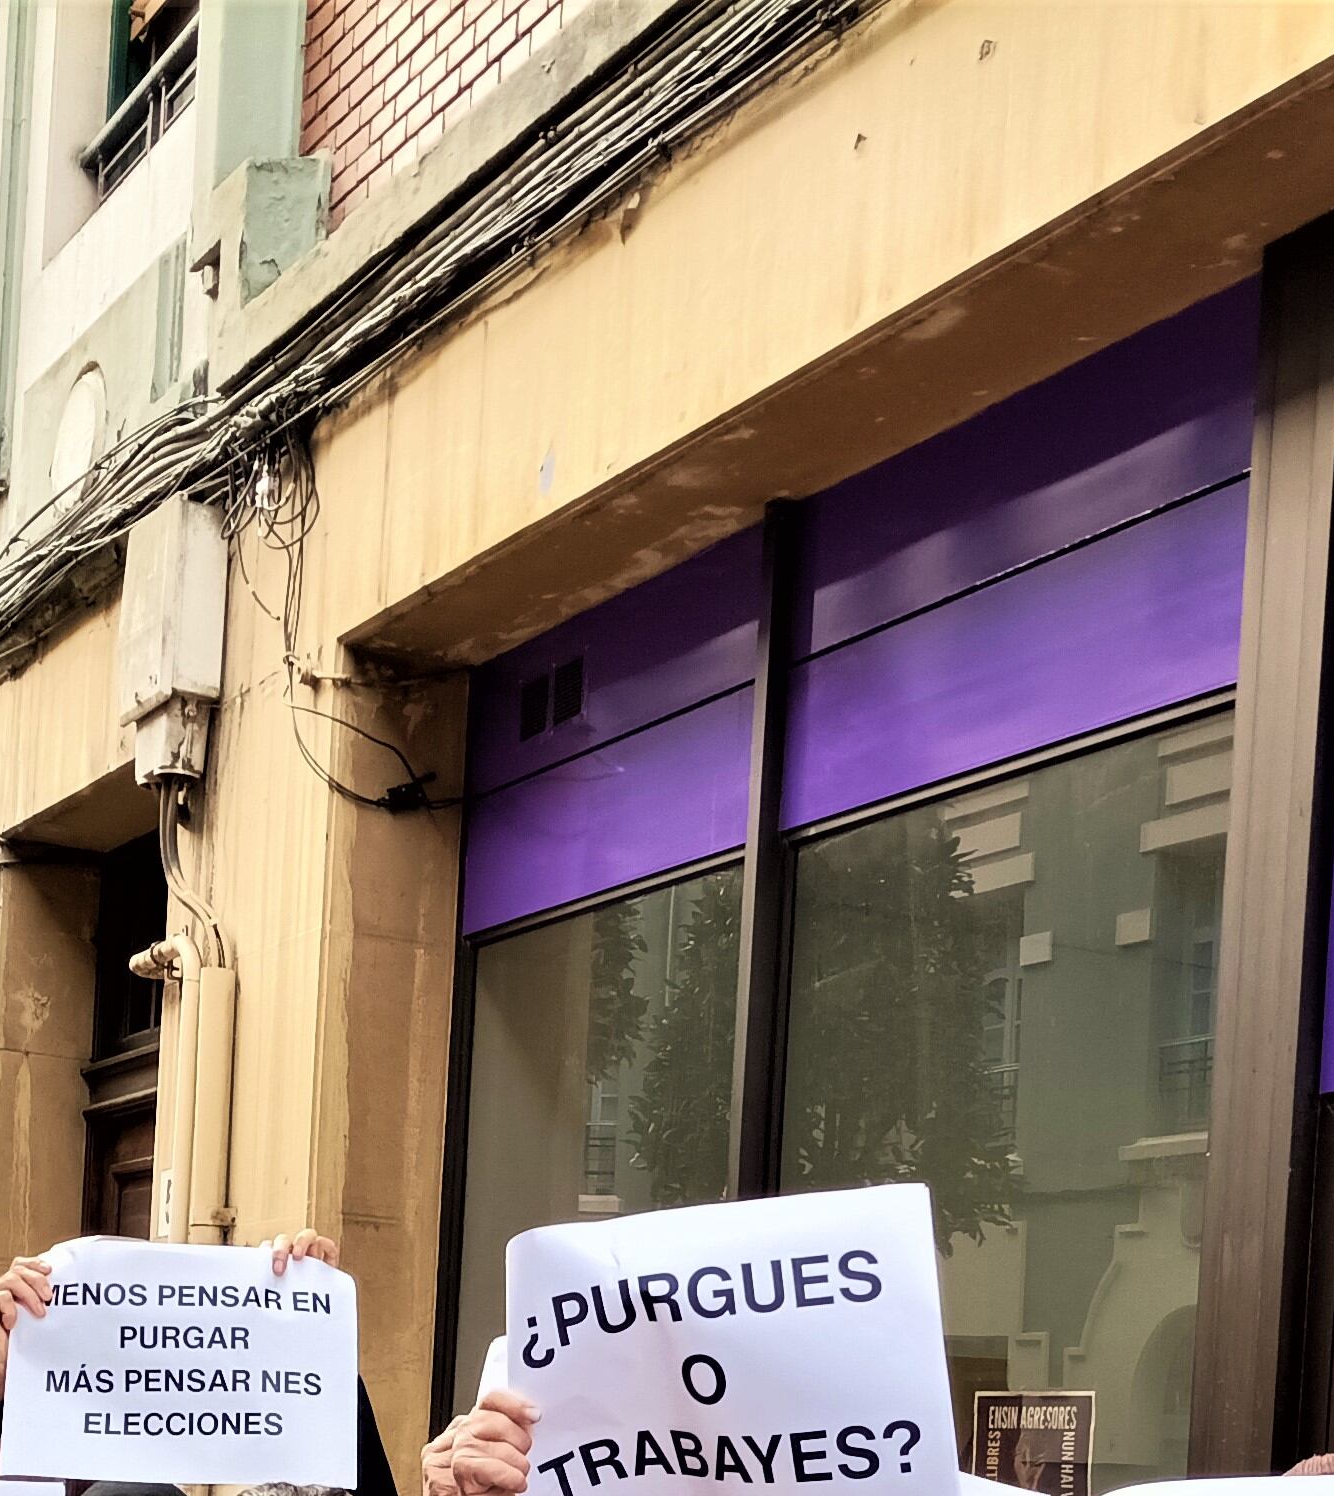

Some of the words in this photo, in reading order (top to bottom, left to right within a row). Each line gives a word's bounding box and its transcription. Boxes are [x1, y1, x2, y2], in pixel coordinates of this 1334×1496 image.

[158, 1285, 282, 1311] PENSAR
[292, 1292, 332, 1314] EN
[522, 1249, 882, 1369] ¿PURGUES
[120, 1325, 250, 1349] PURGAR
[45, 1364, 114, 1393] MÁS
[124, 1369, 250, 1393] PENSAR
[261, 1370, 322, 1396] NES
[681, 1354, 726, 1405] O
[83, 1412, 283, 1436] ELECCIONES
[988, 1405, 1018, 1429] ENSIN
[1020, 1405, 1077, 1430] AGRESORES
[1061, 1431, 1075, 1461] NUN
[1060, 1464, 1074, 1488] HAI
